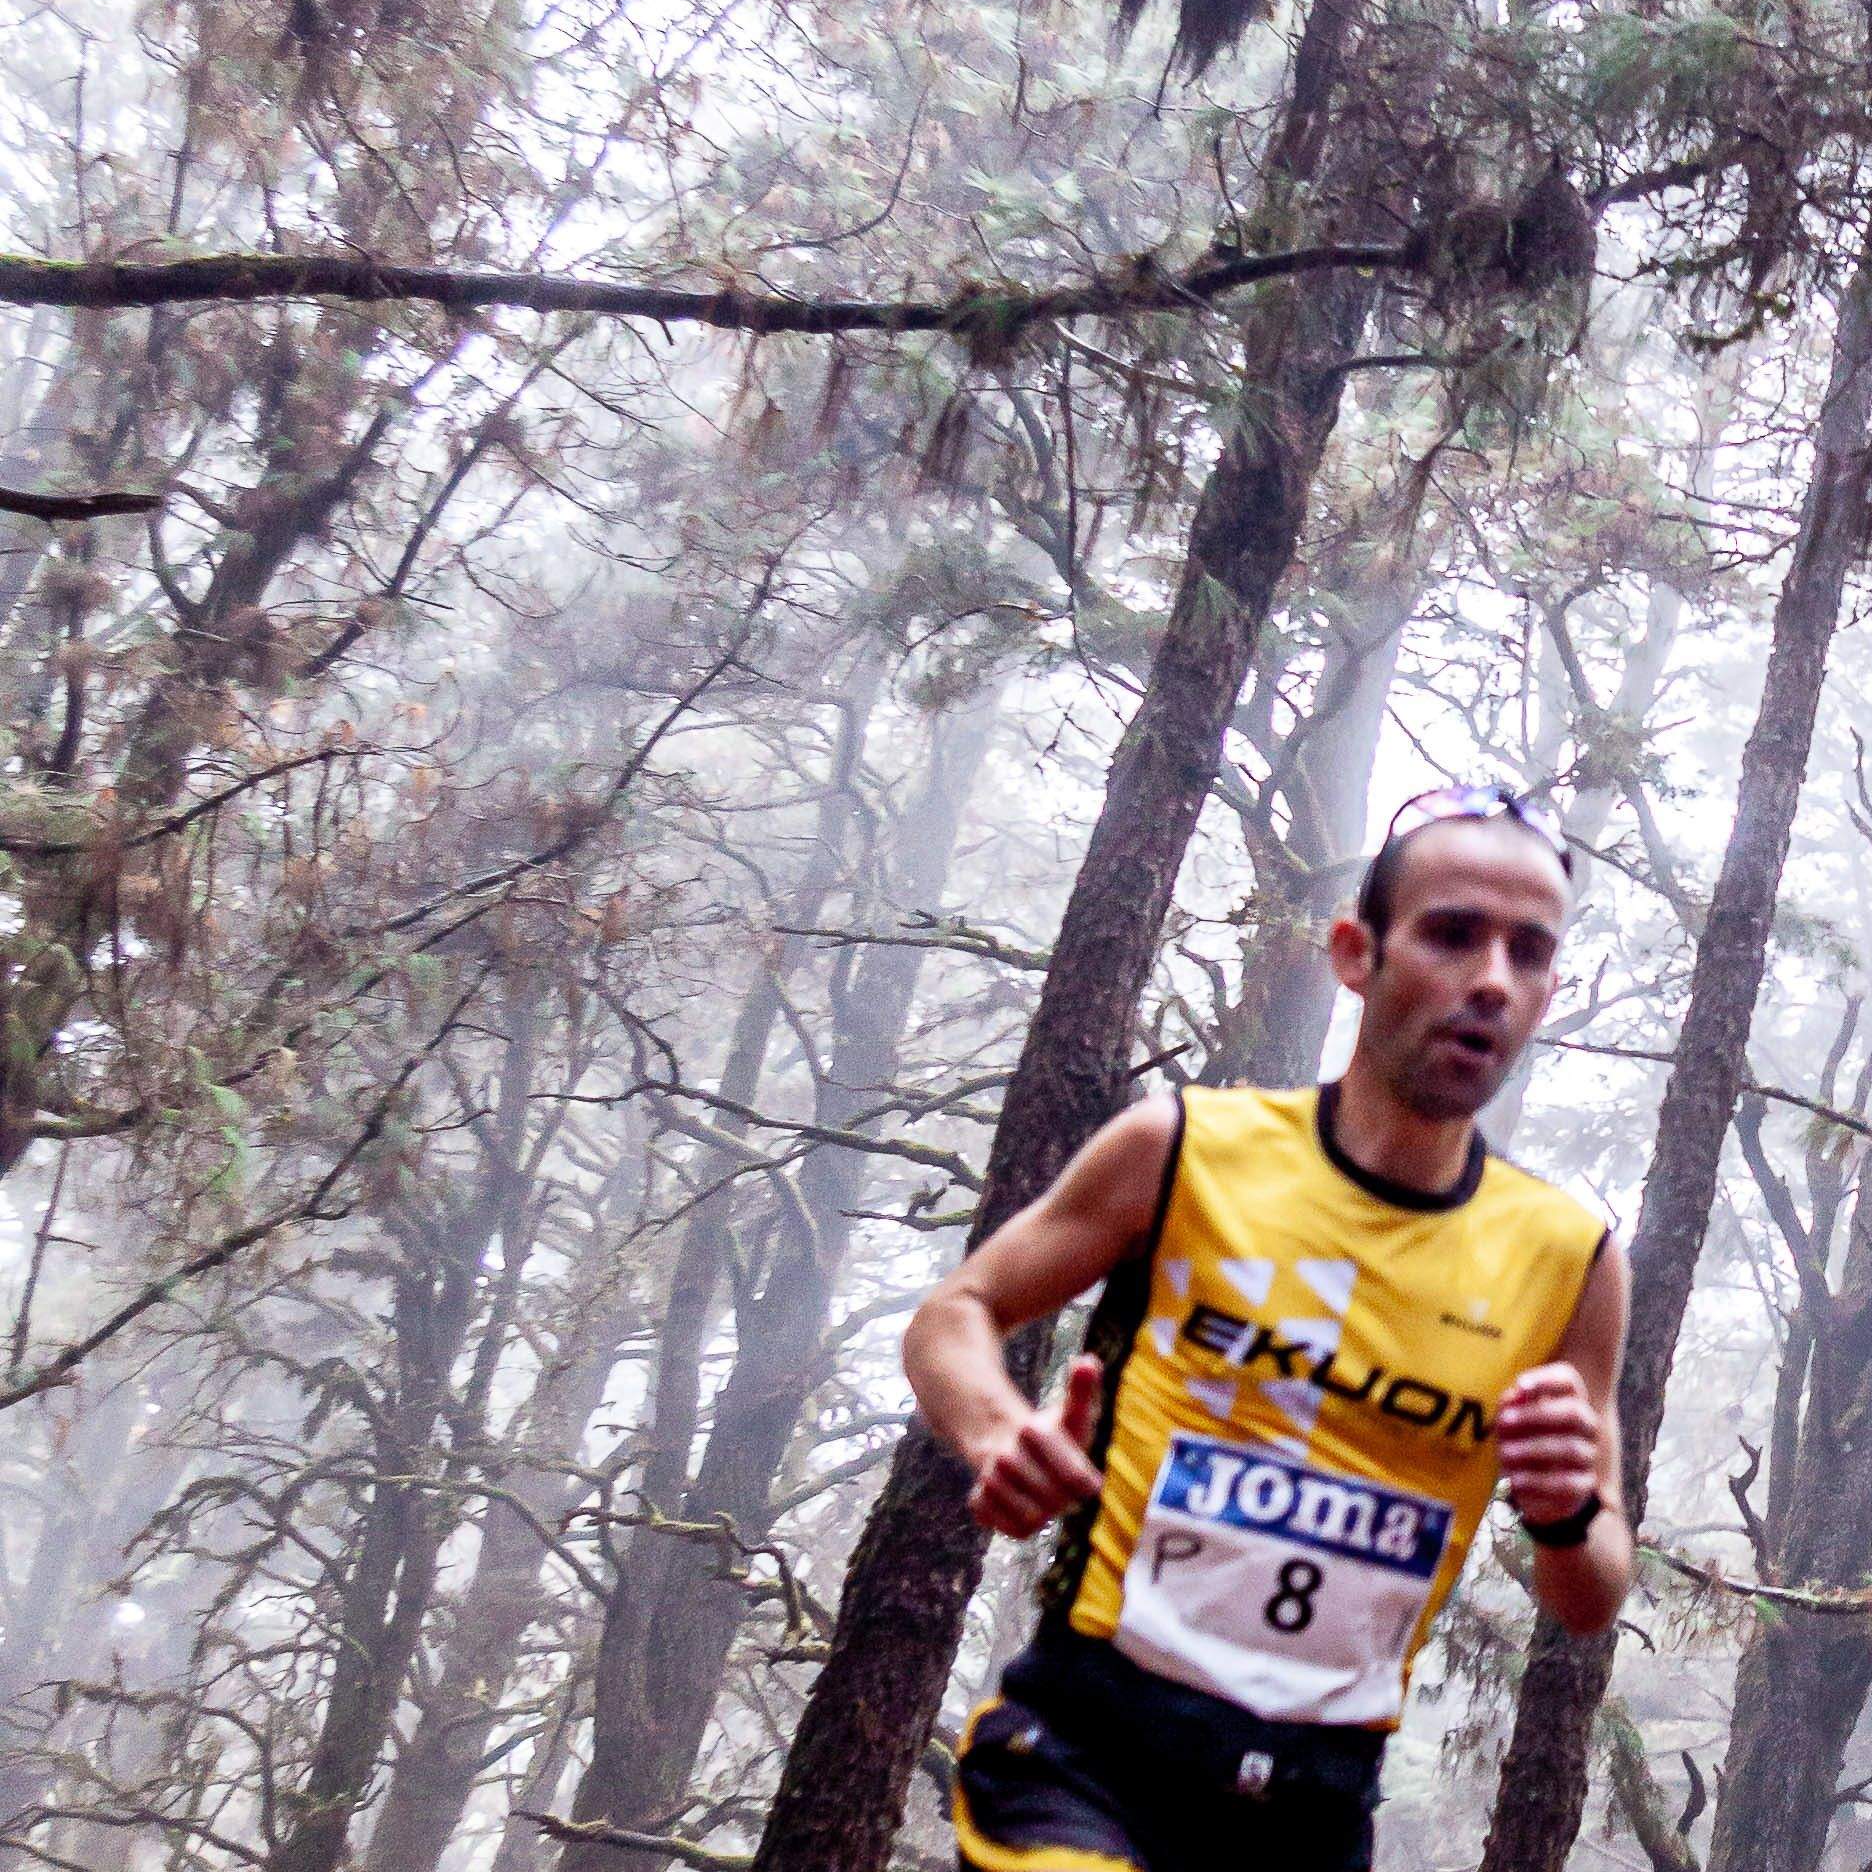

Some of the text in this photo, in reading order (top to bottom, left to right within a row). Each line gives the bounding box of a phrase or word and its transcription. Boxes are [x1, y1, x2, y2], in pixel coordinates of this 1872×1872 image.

[1185, 1453, 1421, 1562] Joma
[1152, 1530, 1323, 1632] P 8
